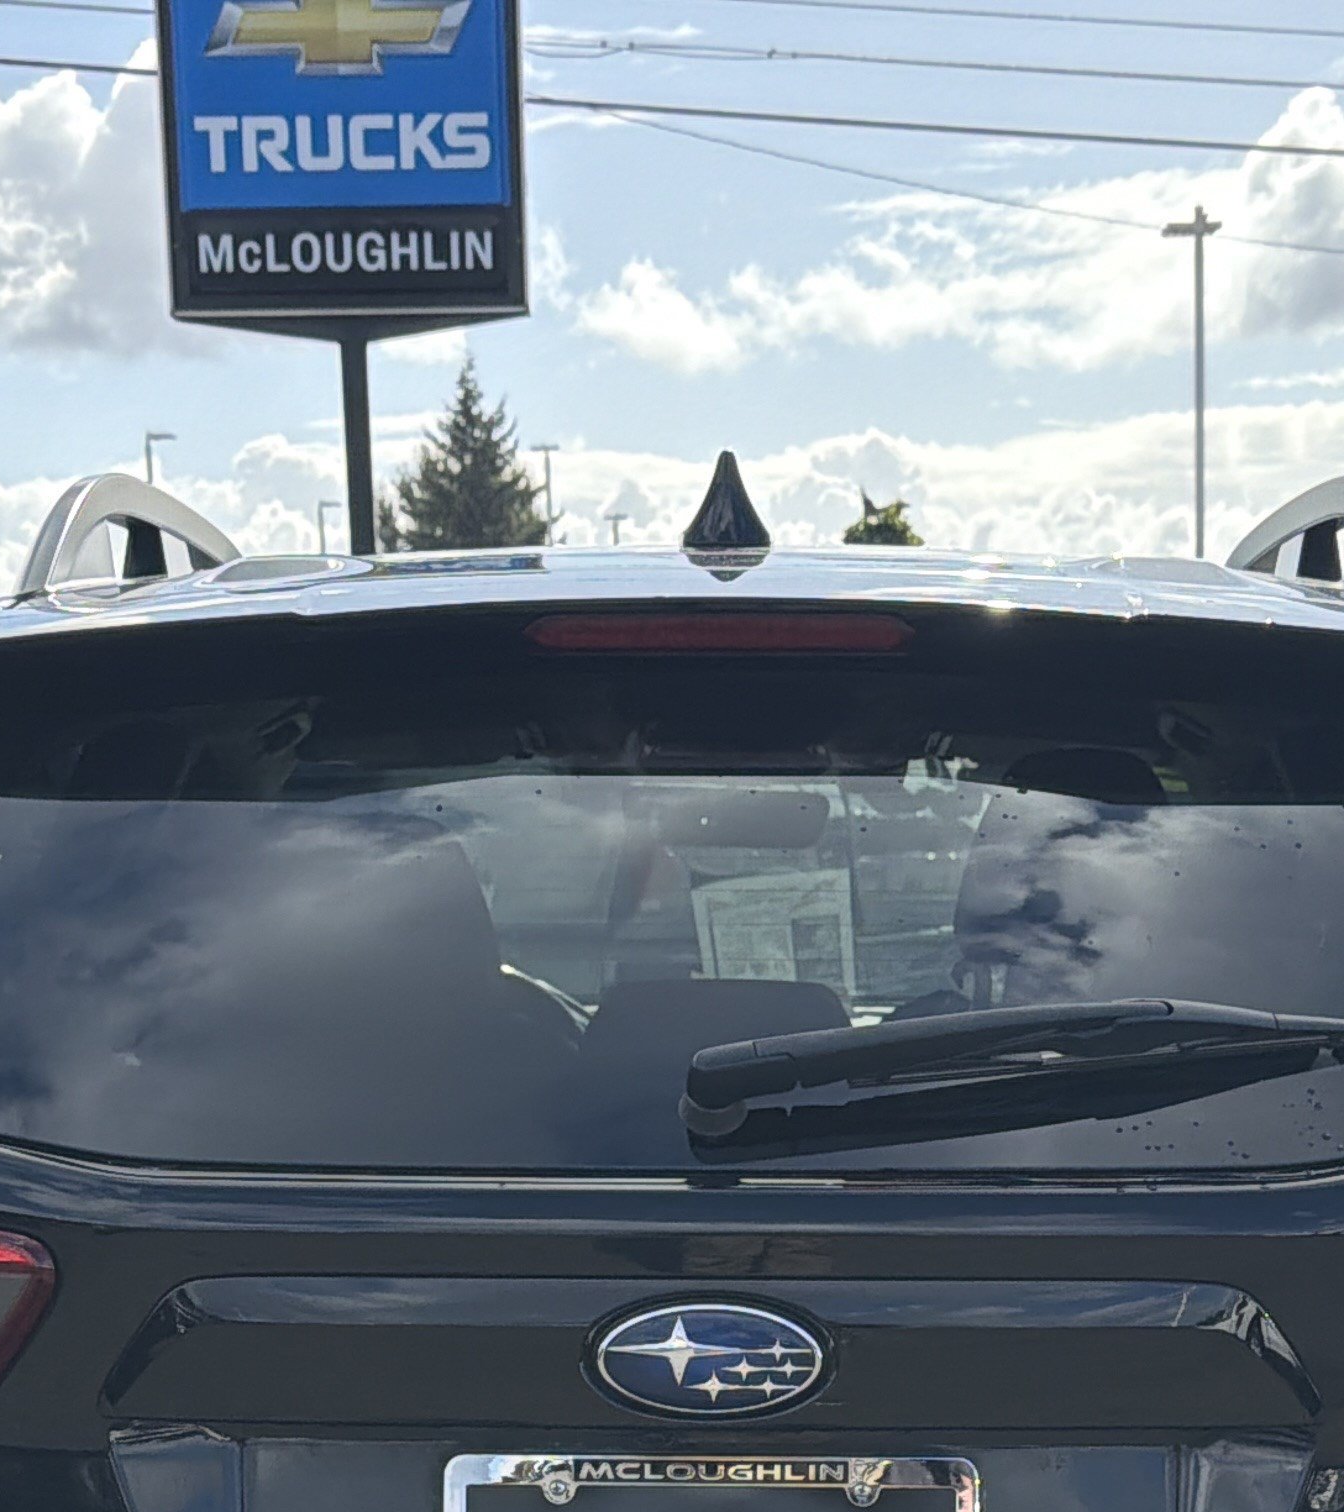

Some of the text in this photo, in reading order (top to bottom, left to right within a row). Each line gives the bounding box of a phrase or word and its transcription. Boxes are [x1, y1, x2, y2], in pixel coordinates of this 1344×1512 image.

[194, 112, 491, 172] TRUCKS
[197, 230, 494, 273] McLOUGHLIN
[578, 1460, 845, 1482] MCLOUGHLIN
